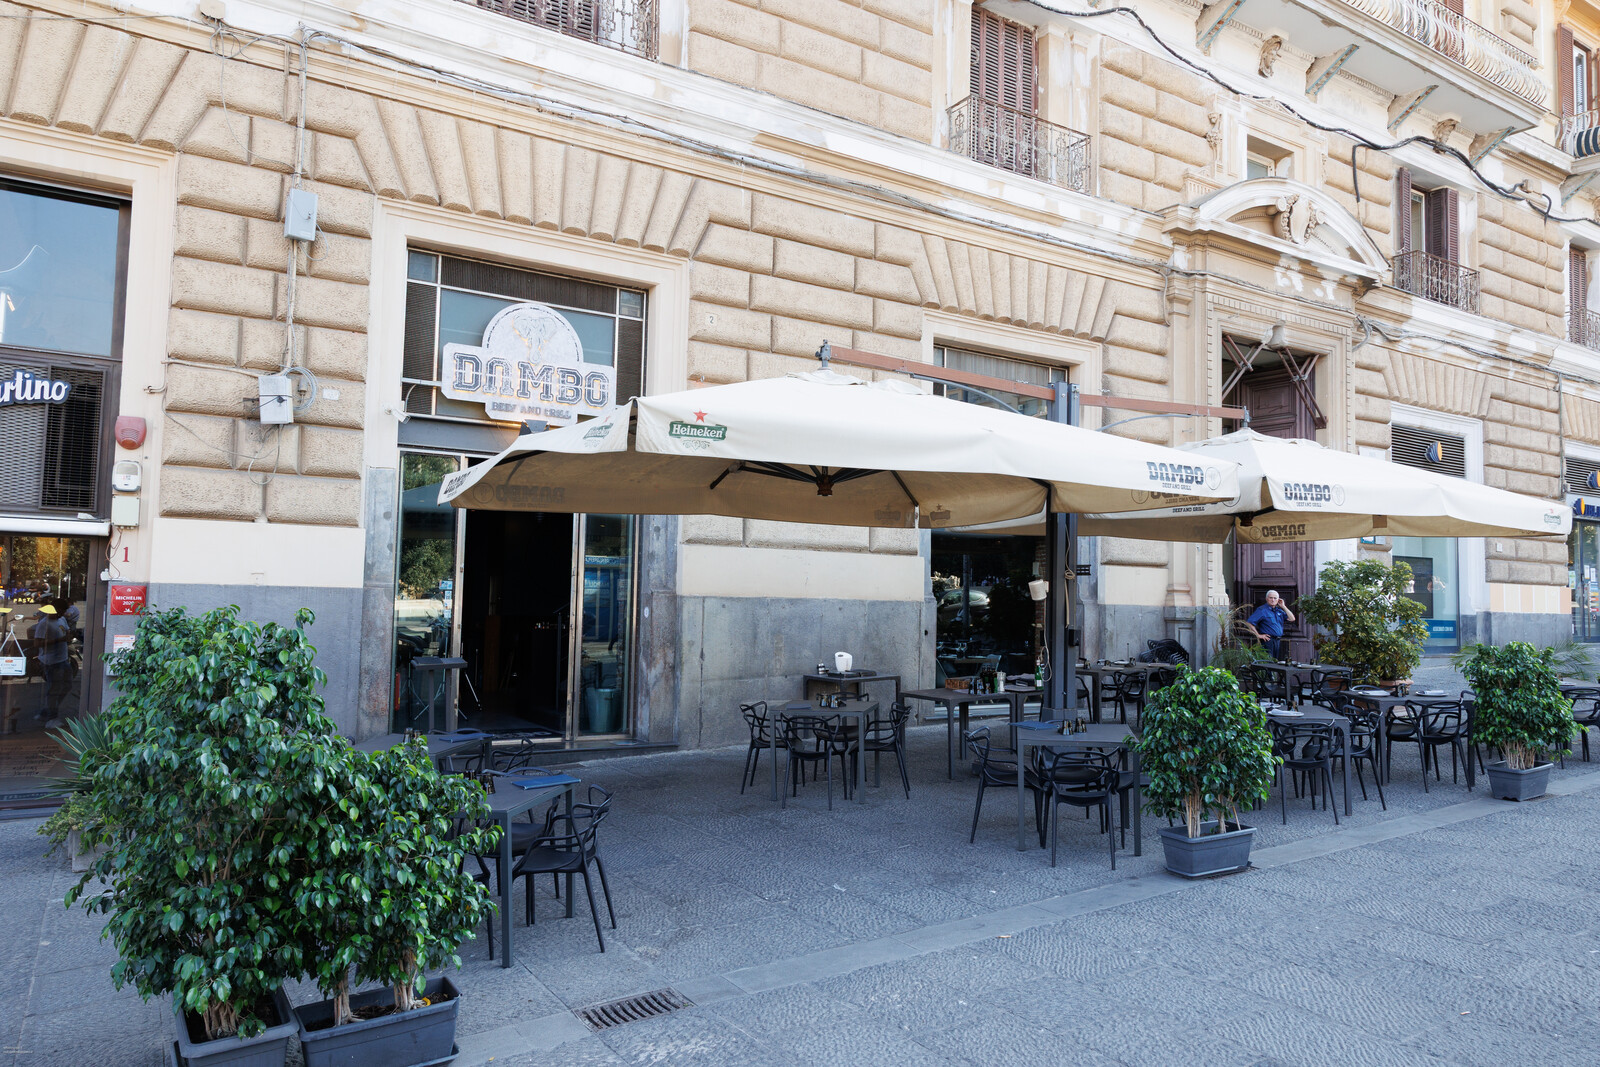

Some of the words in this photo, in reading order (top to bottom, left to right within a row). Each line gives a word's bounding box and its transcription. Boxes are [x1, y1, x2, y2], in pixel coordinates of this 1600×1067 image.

[453, 352, 610, 407] DAMBO
[492, 401, 517, 413] BEEF
[520, 405, 542, 416] AND
[672, 423, 723, 438] Heineken
[1147, 462, 1204, 485] DAMBO
[1284, 483, 1331, 502] DAMBO
[122, 547, 130, 562] 1
